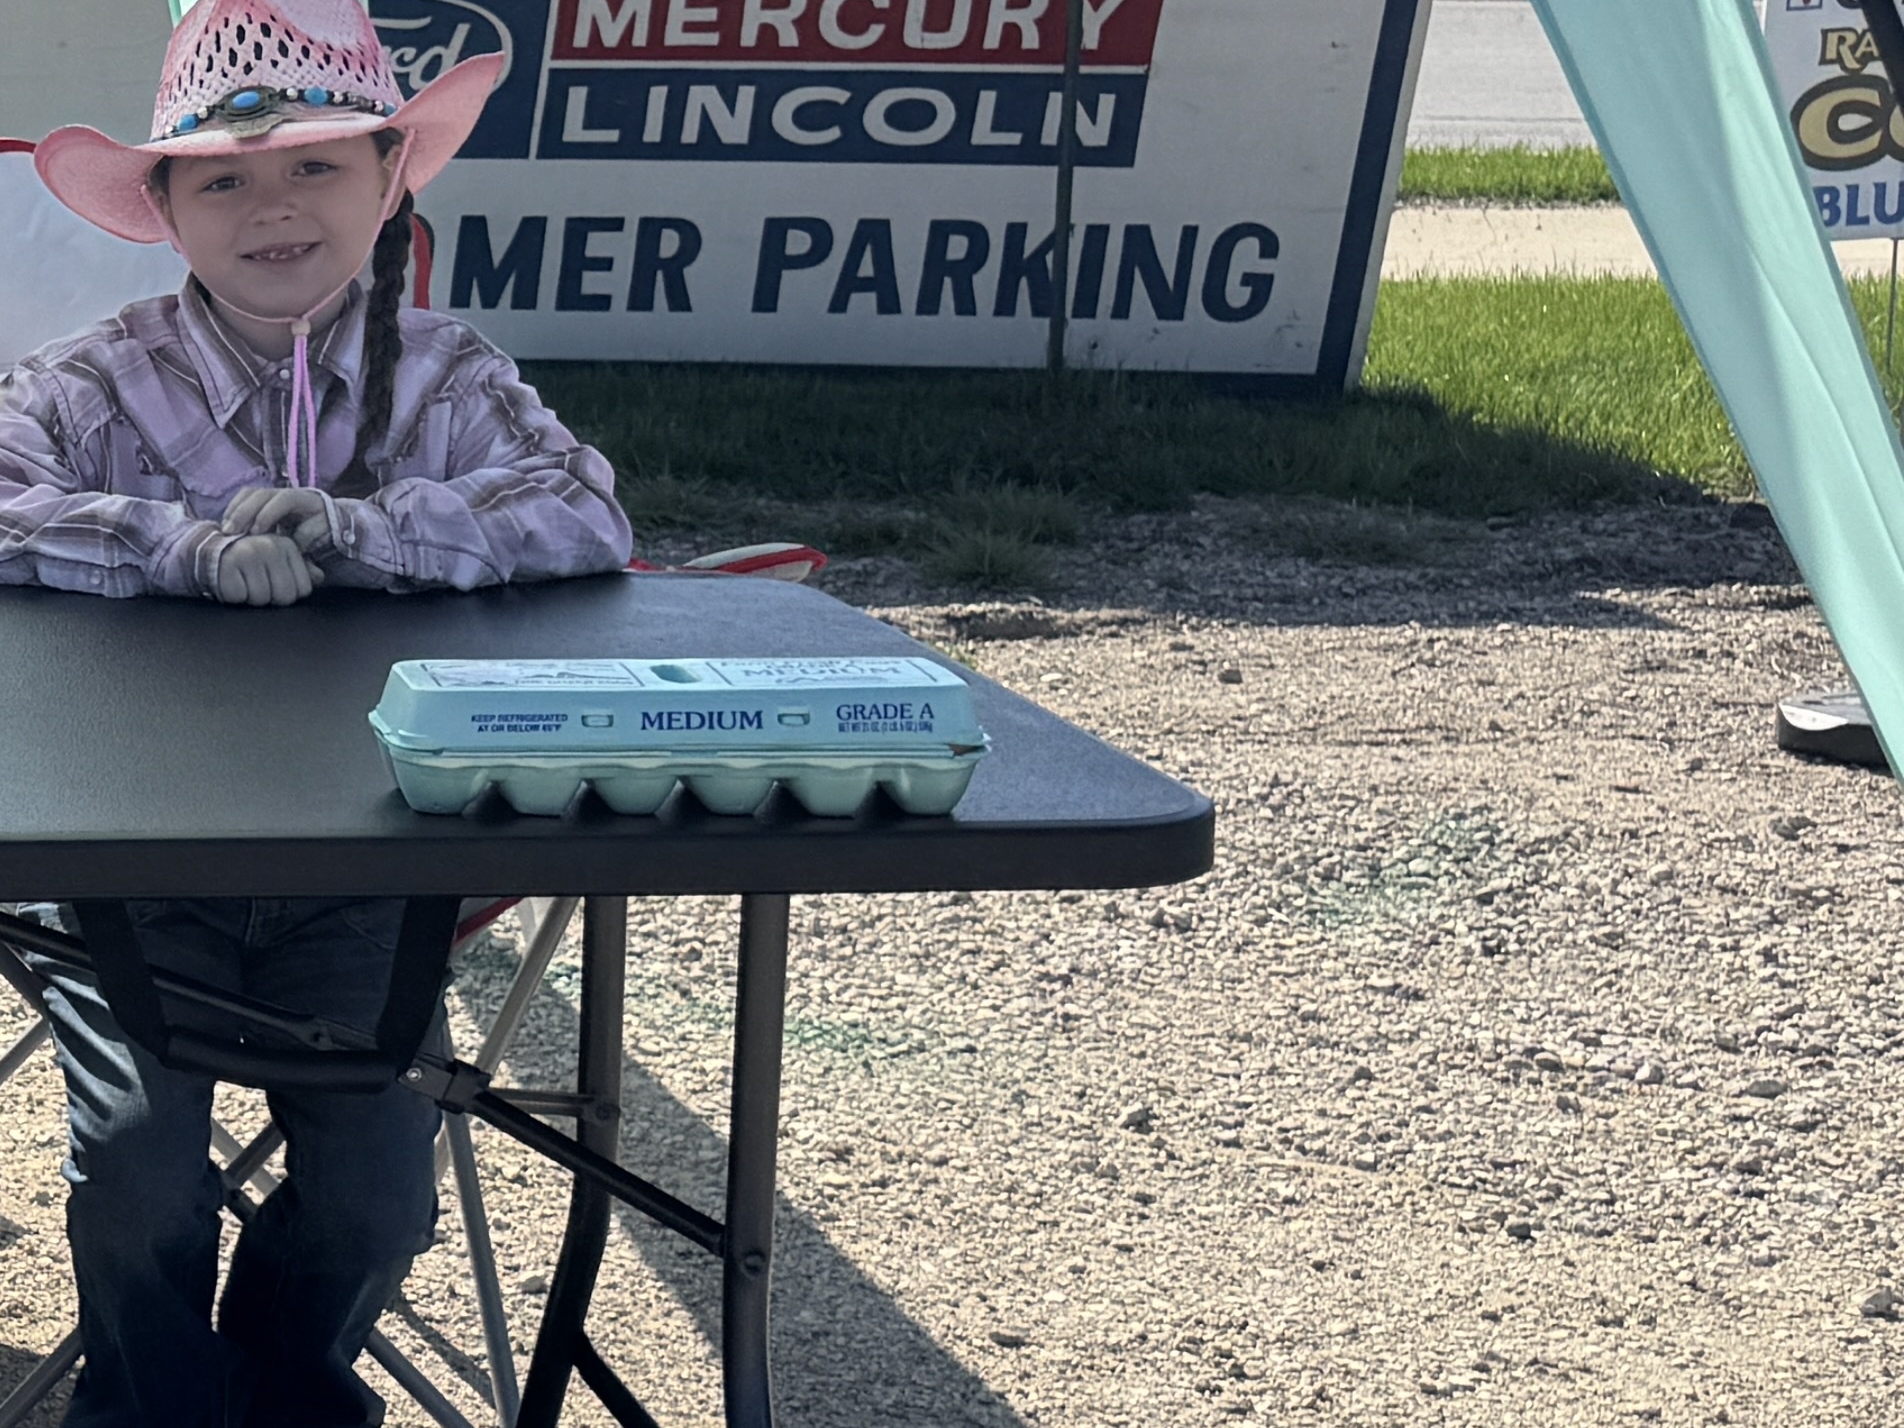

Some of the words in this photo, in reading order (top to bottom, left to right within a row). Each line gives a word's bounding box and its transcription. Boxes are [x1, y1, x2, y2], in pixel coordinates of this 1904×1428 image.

[562, 84, 1117, 148] LINCOLN
[449, 214, 703, 313] MER
[751, 215, 1281, 323] PARKING
[640, 710, 764, 732] MEDIUM
[836, 703, 913, 721] GRADE
[919, 703, 935, 720] A
